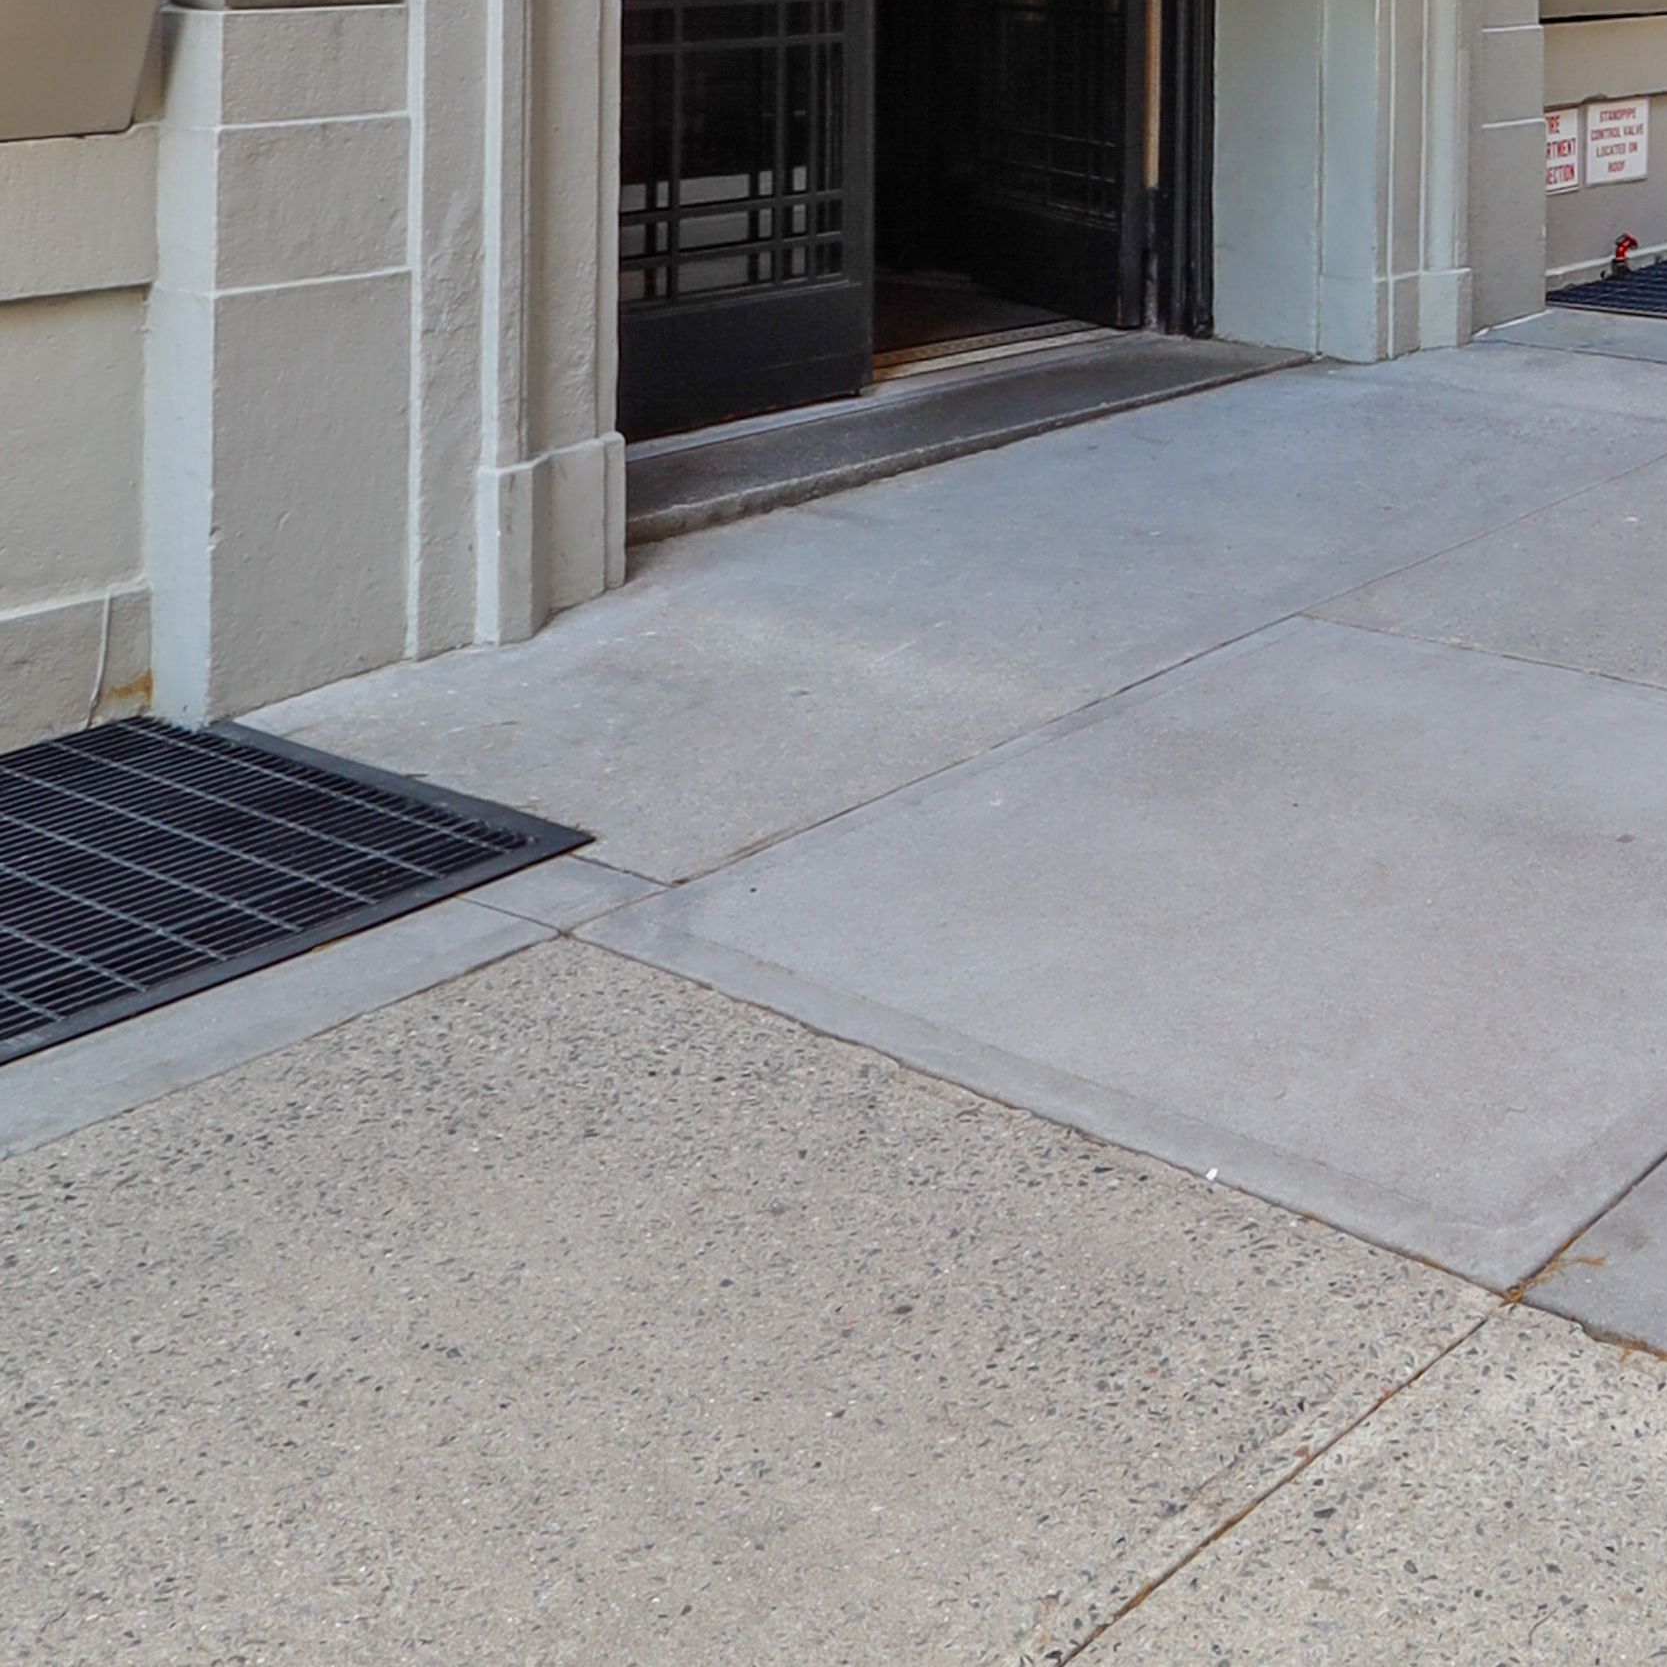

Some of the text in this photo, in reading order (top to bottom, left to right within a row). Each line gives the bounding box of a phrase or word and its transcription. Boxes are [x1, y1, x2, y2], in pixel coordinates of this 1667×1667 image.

[1600, 108, 1636, 122] STANDPIPE
[1591, 123, 1644, 141] CONTROL VALVE
[1546, 138, 1576, 159] RTMENT
[1596, 141, 1638, 157] LOCATED ON
[1546, 164, 1575, 184] ECTION
[1608, 160, 1626, 173] ROOF
